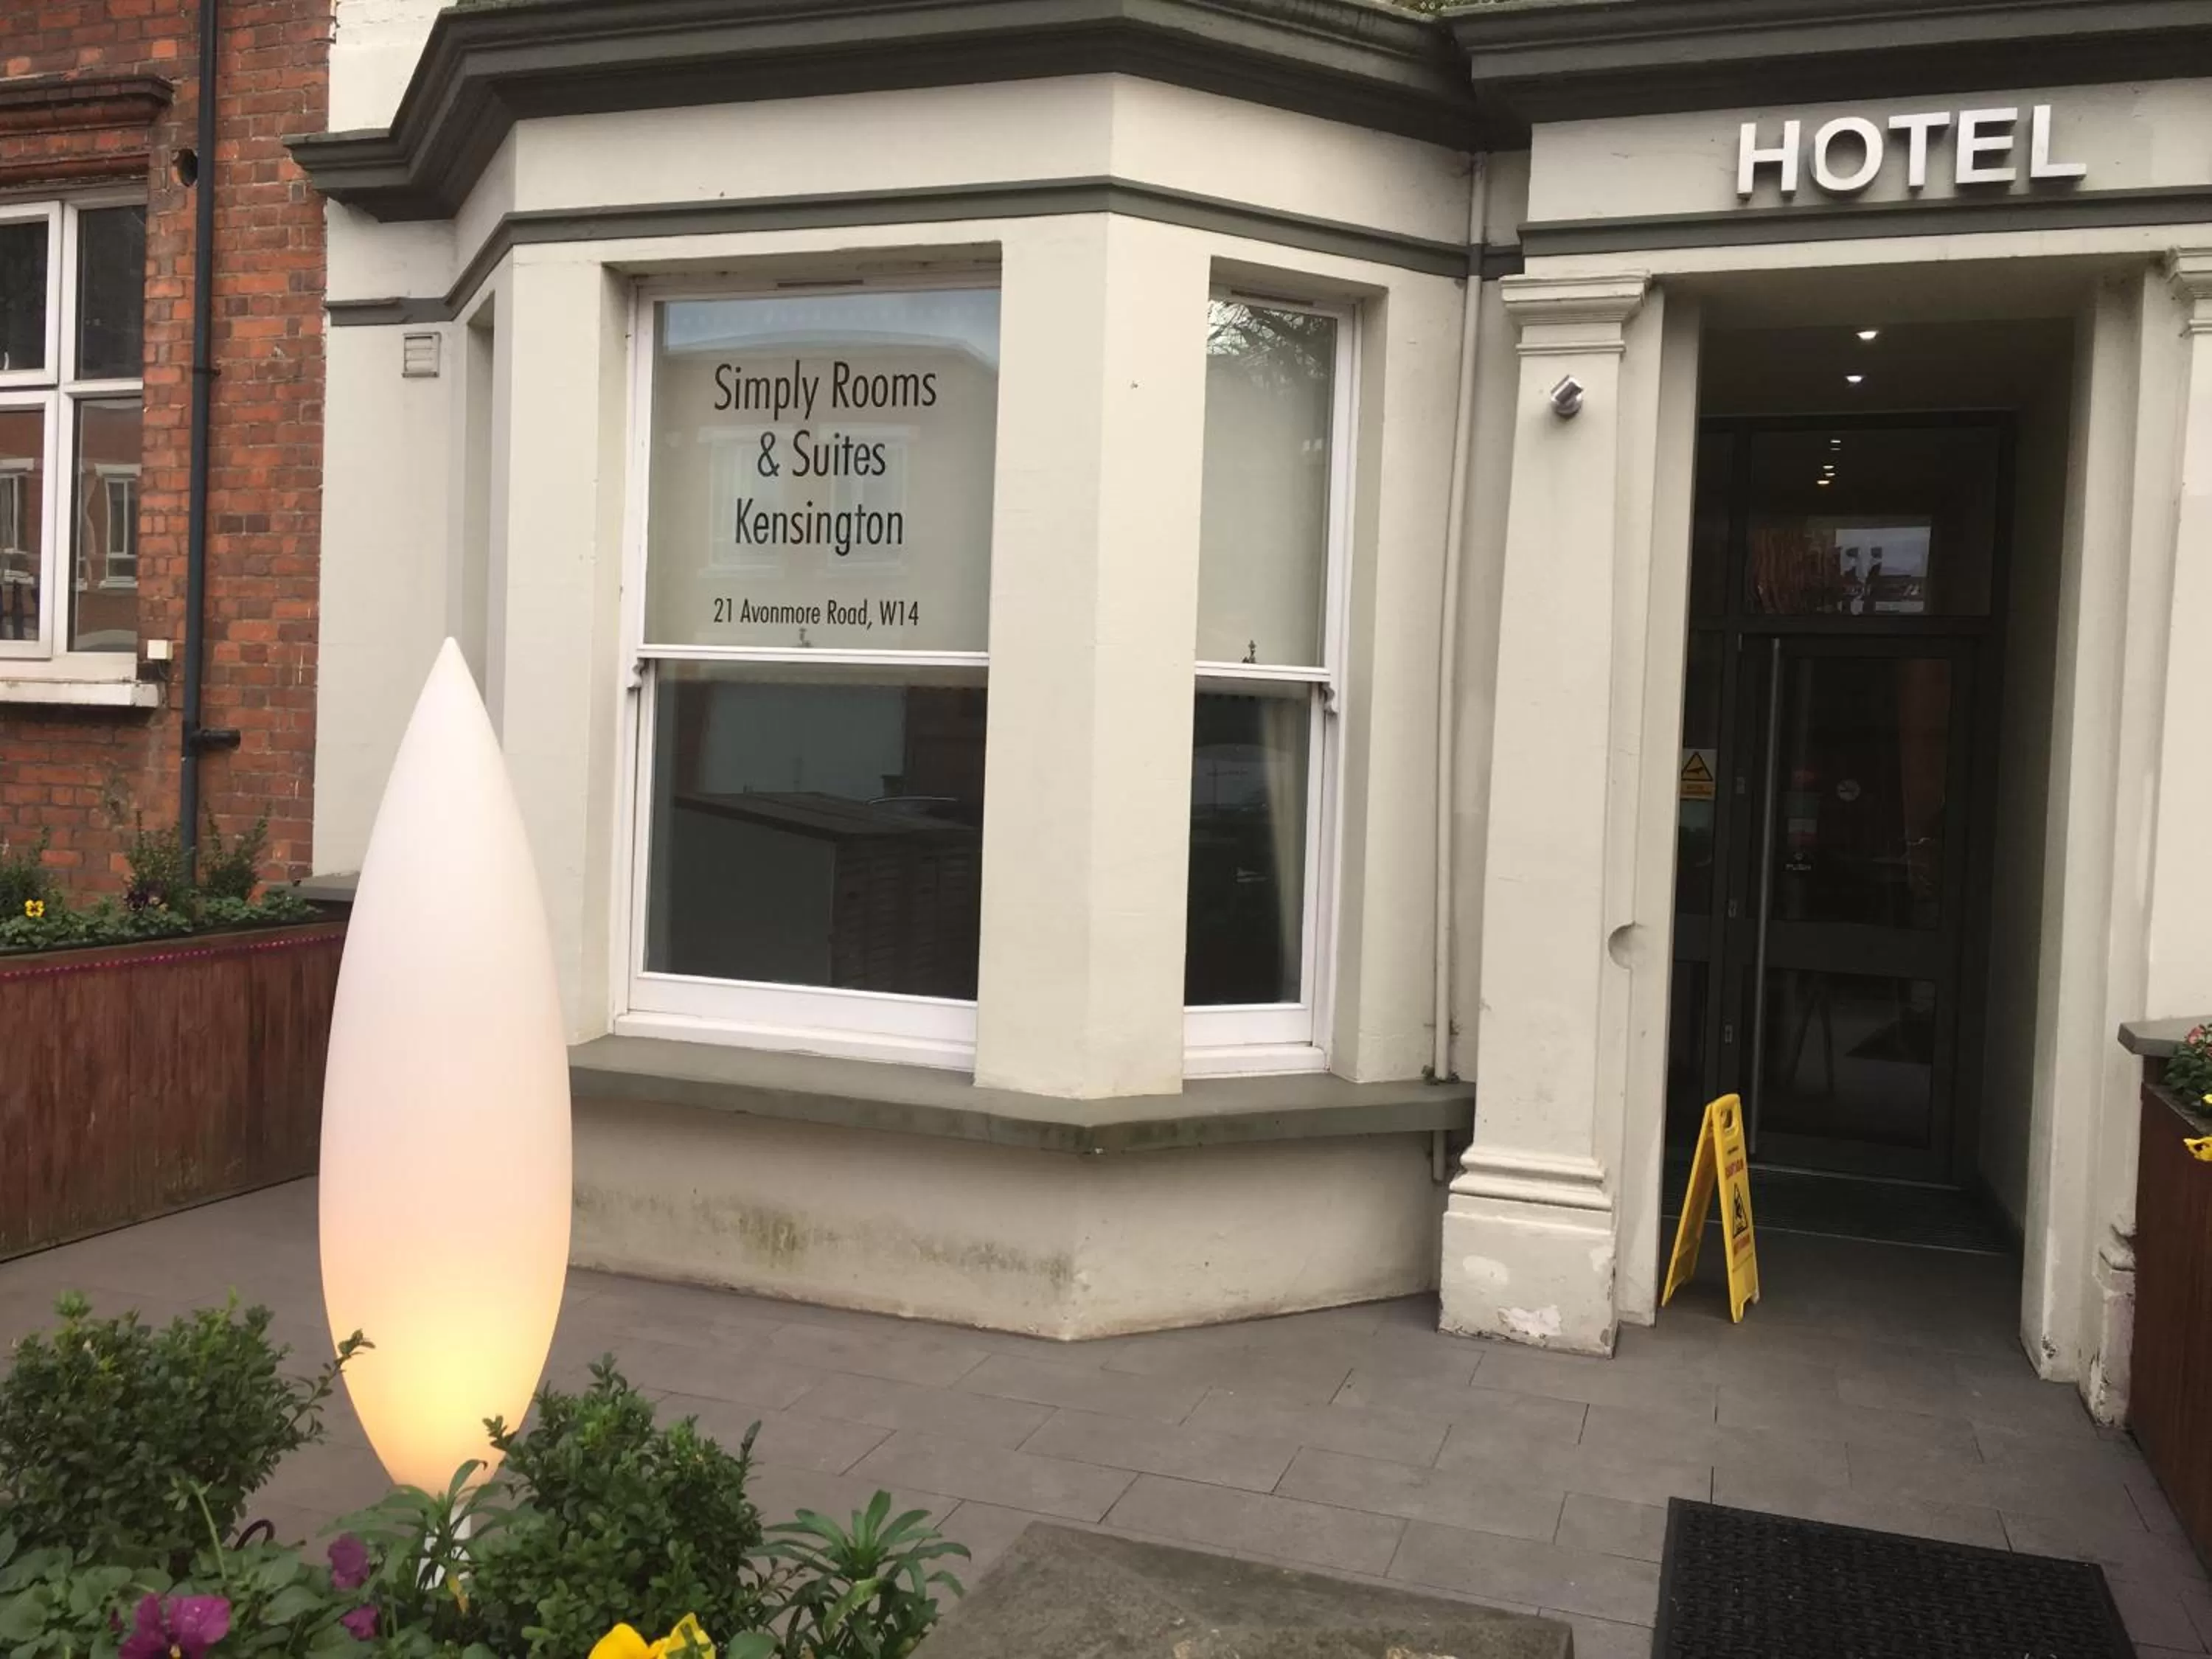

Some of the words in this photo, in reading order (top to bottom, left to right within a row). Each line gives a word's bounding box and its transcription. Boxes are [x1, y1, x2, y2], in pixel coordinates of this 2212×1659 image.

[1736, 105, 2087, 197] HOTEL
[714, 360, 819, 420] Simply
[832, 361, 937, 408] Rooms
[758, 431, 779, 477] &
[793, 430, 886, 477] Suites
[735, 498, 903, 556] Kensington
[714, 599, 732, 623] 21
[740, 599, 821, 624] Avonmore
[827, 599, 872, 630] Road,
[880, 601, 919, 626] W14
